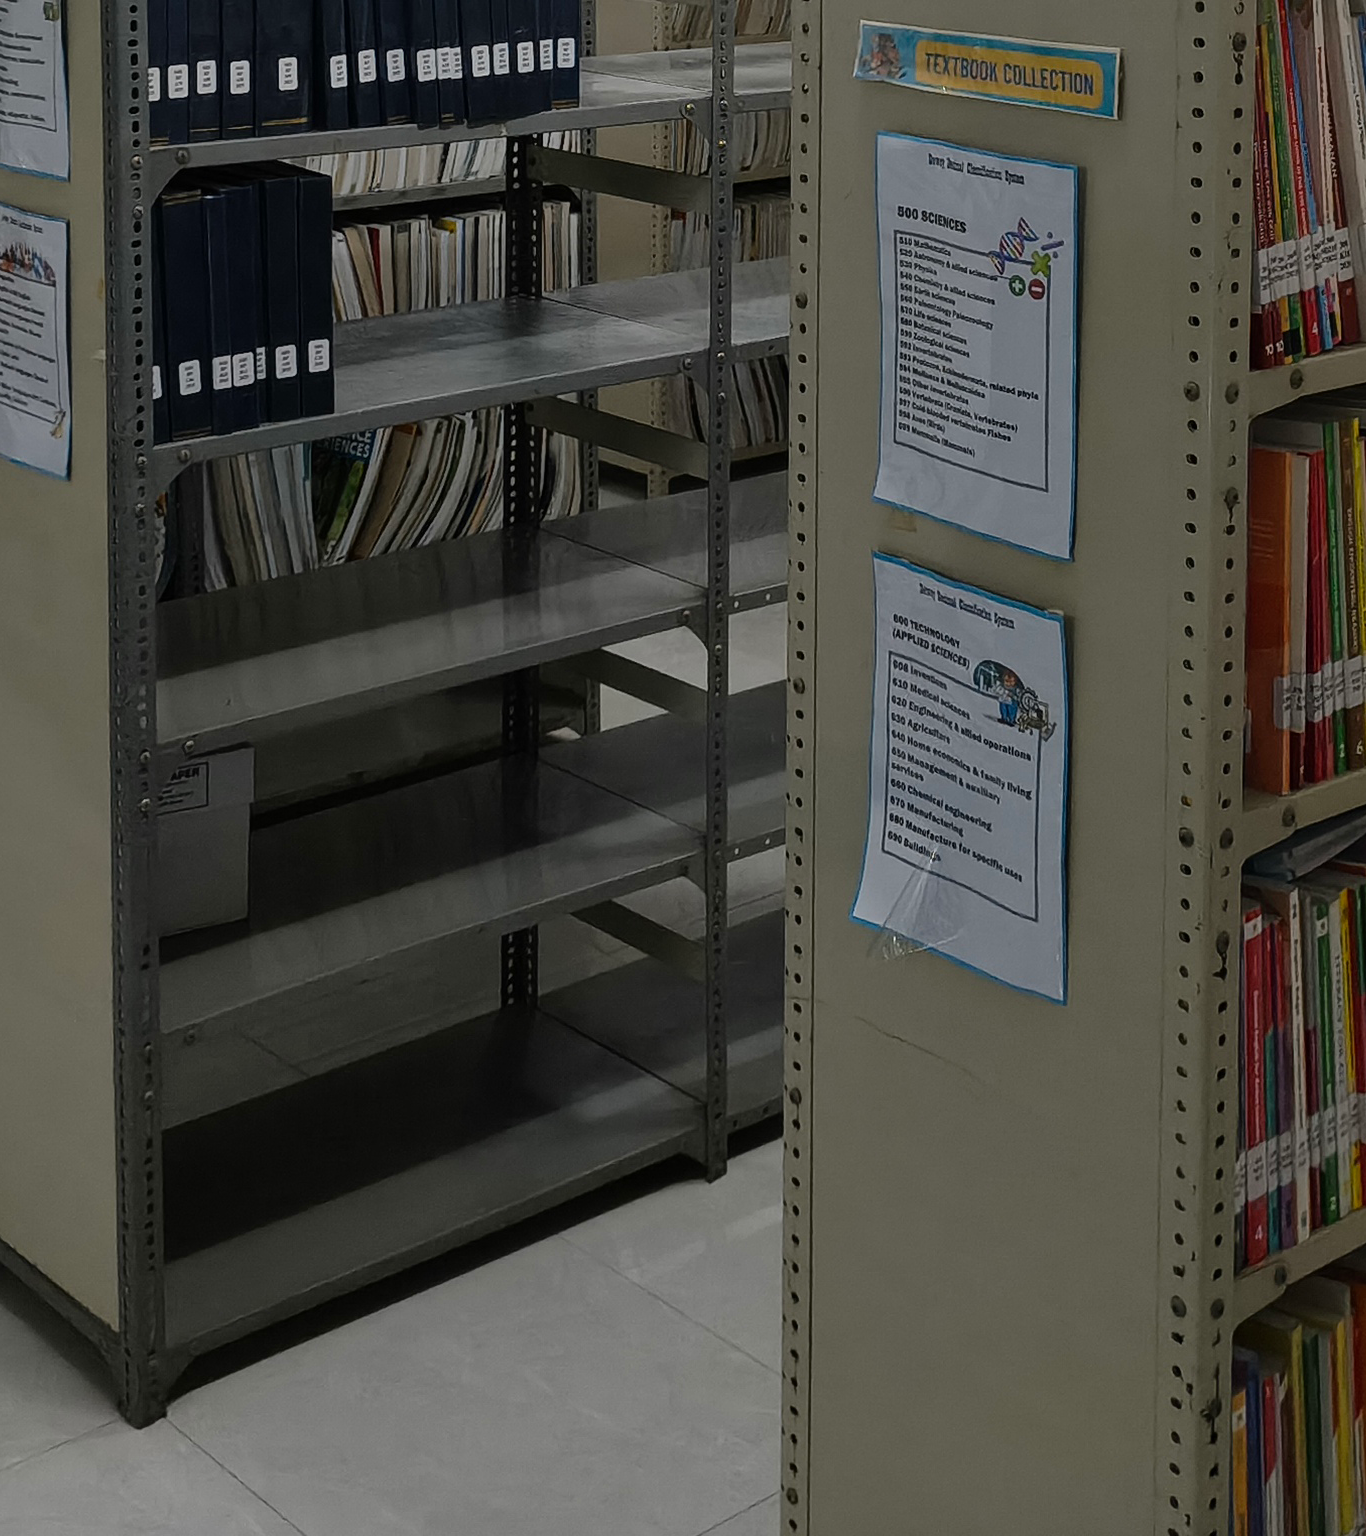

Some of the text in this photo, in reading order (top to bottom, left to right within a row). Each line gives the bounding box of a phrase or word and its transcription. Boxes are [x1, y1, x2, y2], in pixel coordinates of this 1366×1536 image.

[925, 52, 1094, 96] TEXTBOOK COLLECTION
[897, 206, 966, 233] 500 SCIENCES
[910, 619, 960, 648] TECHNOLOGY
[892, 628, 970, 670] (APPLIED SCIENCES)
[910, 683, 939, 703] Medical
[984, 738, 1031, 762] operations
[1355, 740, 1364, 755] 6
[170, 766, 201, 781] APER
[907, 734, 931, 754] Home
[1007, 782, 1032, 801] living
[905, 818, 957, 850] Manufacture
[959, 842, 971, 857] for
[1005, 867, 1023, 883] uses
[1254, 1223, 1265, 1240] 4
